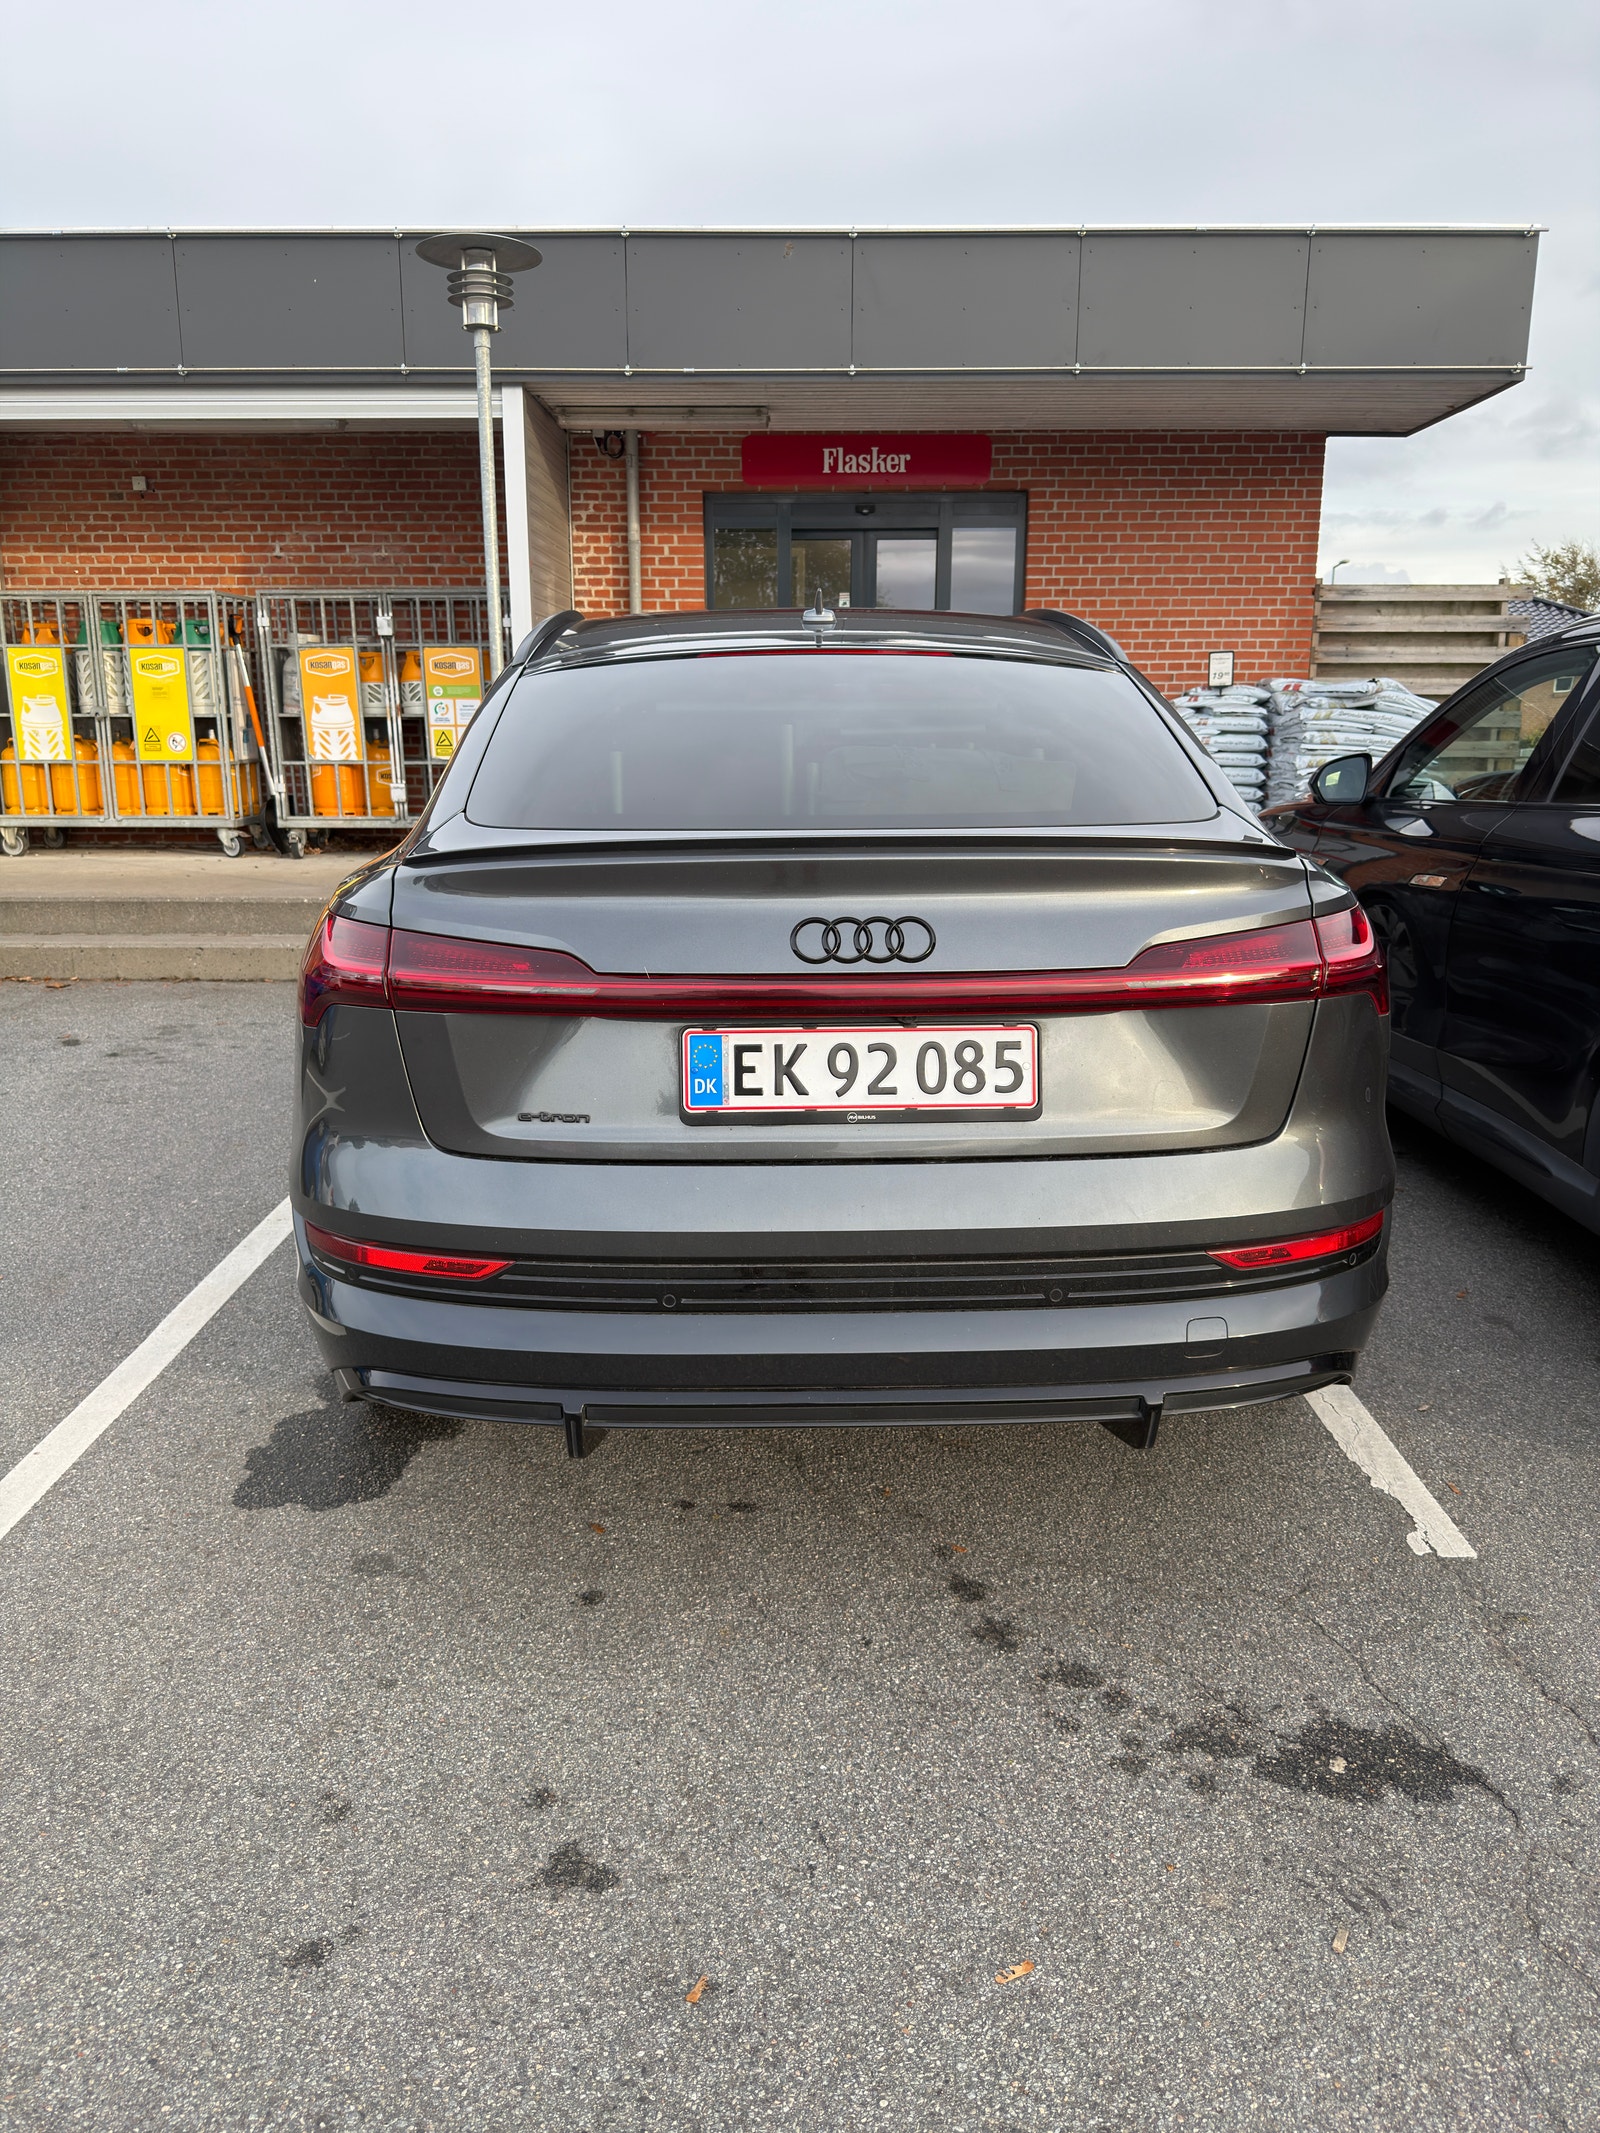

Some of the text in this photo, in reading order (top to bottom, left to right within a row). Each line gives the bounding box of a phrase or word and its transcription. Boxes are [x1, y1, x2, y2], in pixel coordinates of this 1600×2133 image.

[822, 447, 911, 473] Flasker
[733, 1040, 1024, 1098] EK 92 085
[693, 1078, 718, 1094] DK
[518, 1111, 590, 1123] e-tron
